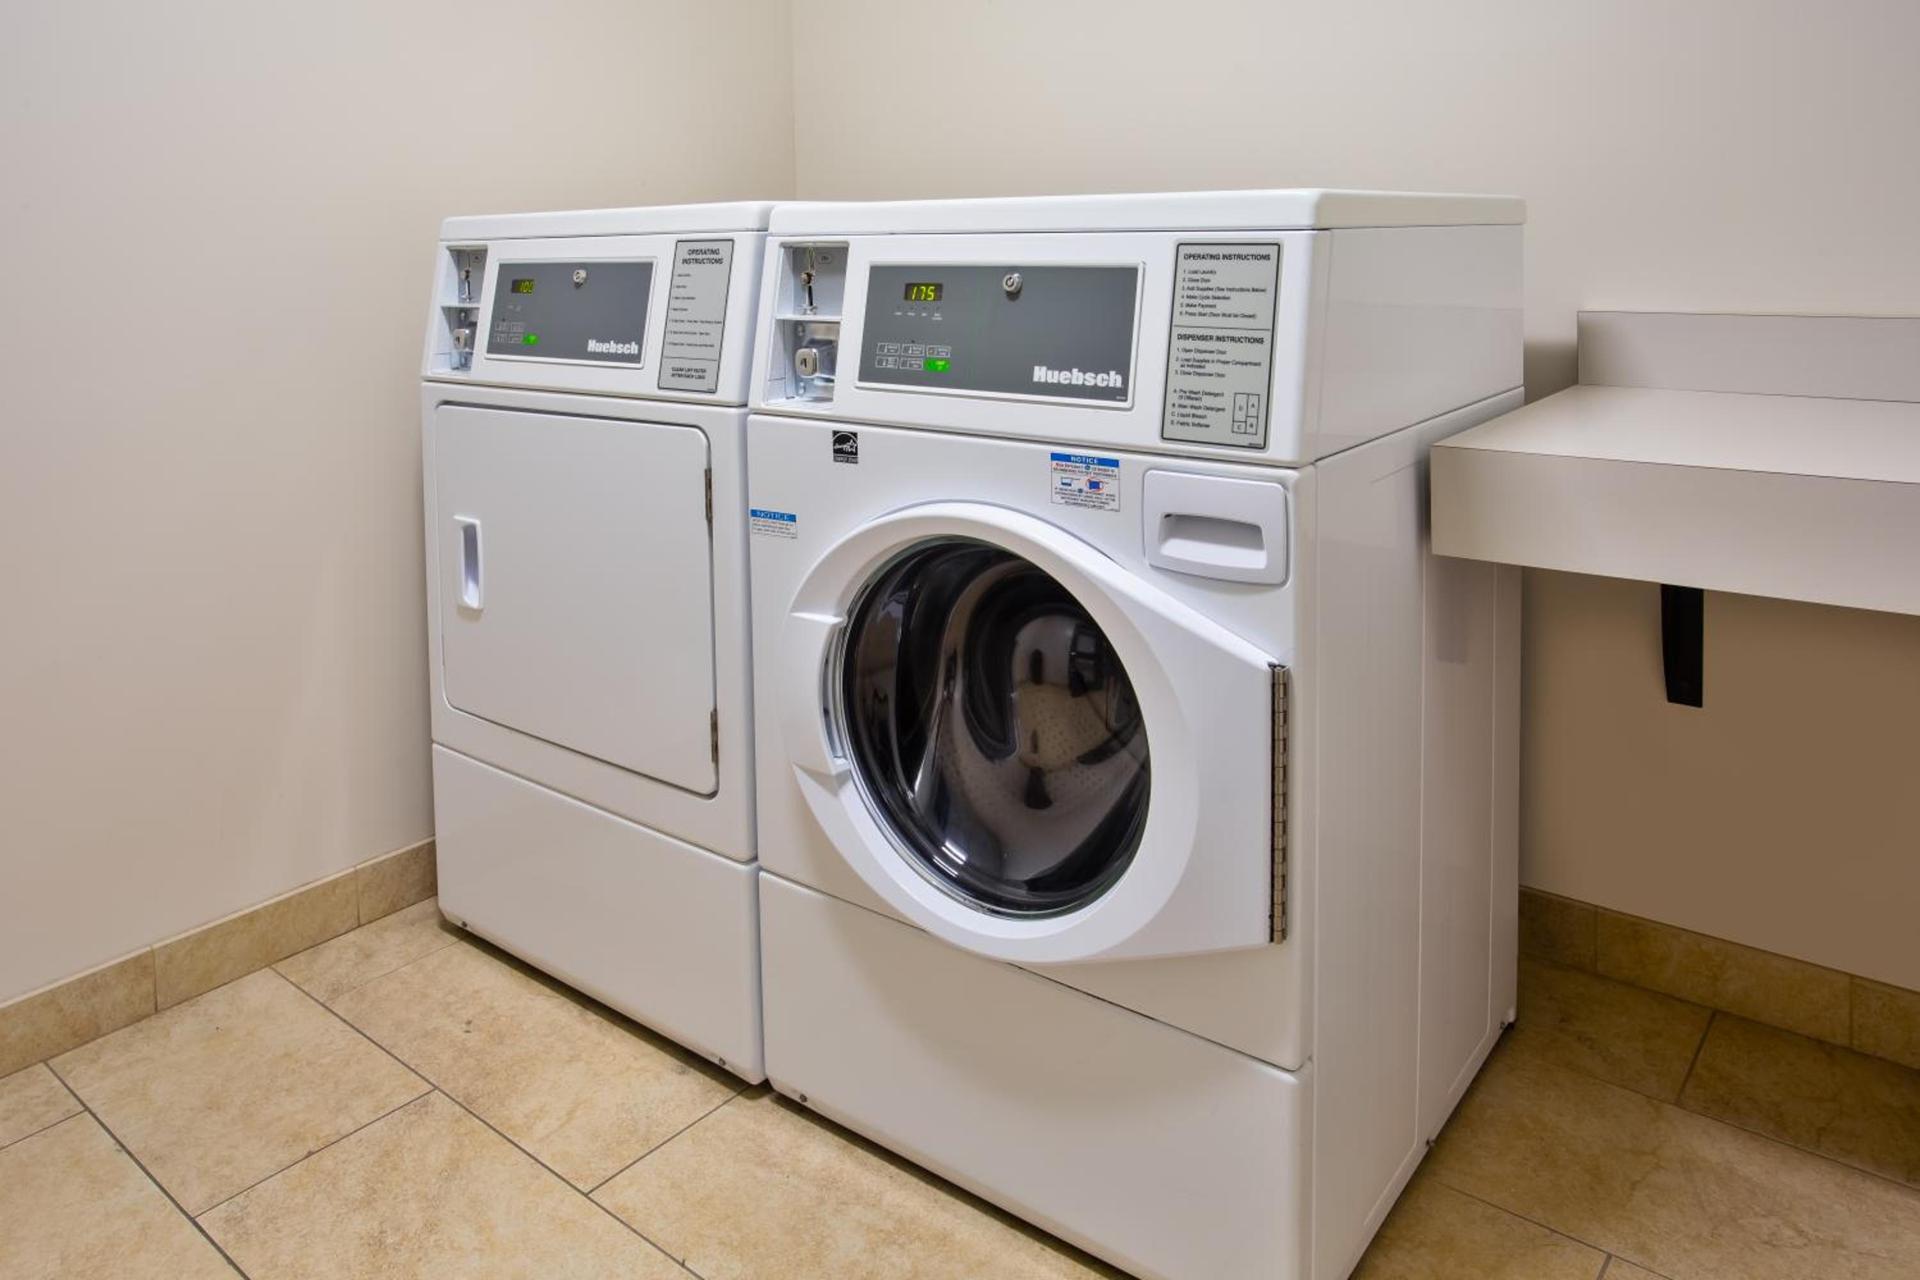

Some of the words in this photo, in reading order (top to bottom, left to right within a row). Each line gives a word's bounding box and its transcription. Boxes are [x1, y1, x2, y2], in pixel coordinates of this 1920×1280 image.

[687, 248, 720, 256] OPERATING
[1183, 253, 1221, 261] OPERATING
[1222, 253, 1271, 261] INSTRUCTIONS
[911, 286, 936, 301] 175
[1177, 333, 1214, 341] DISPENSER
[1215, 335, 1265, 344] INSTRUCTIONS
[587, 339, 639, 355] Huebsch
[1032, 365, 1122, 388] Huebsch
[1070, 456, 1097, 465] NOTICE
